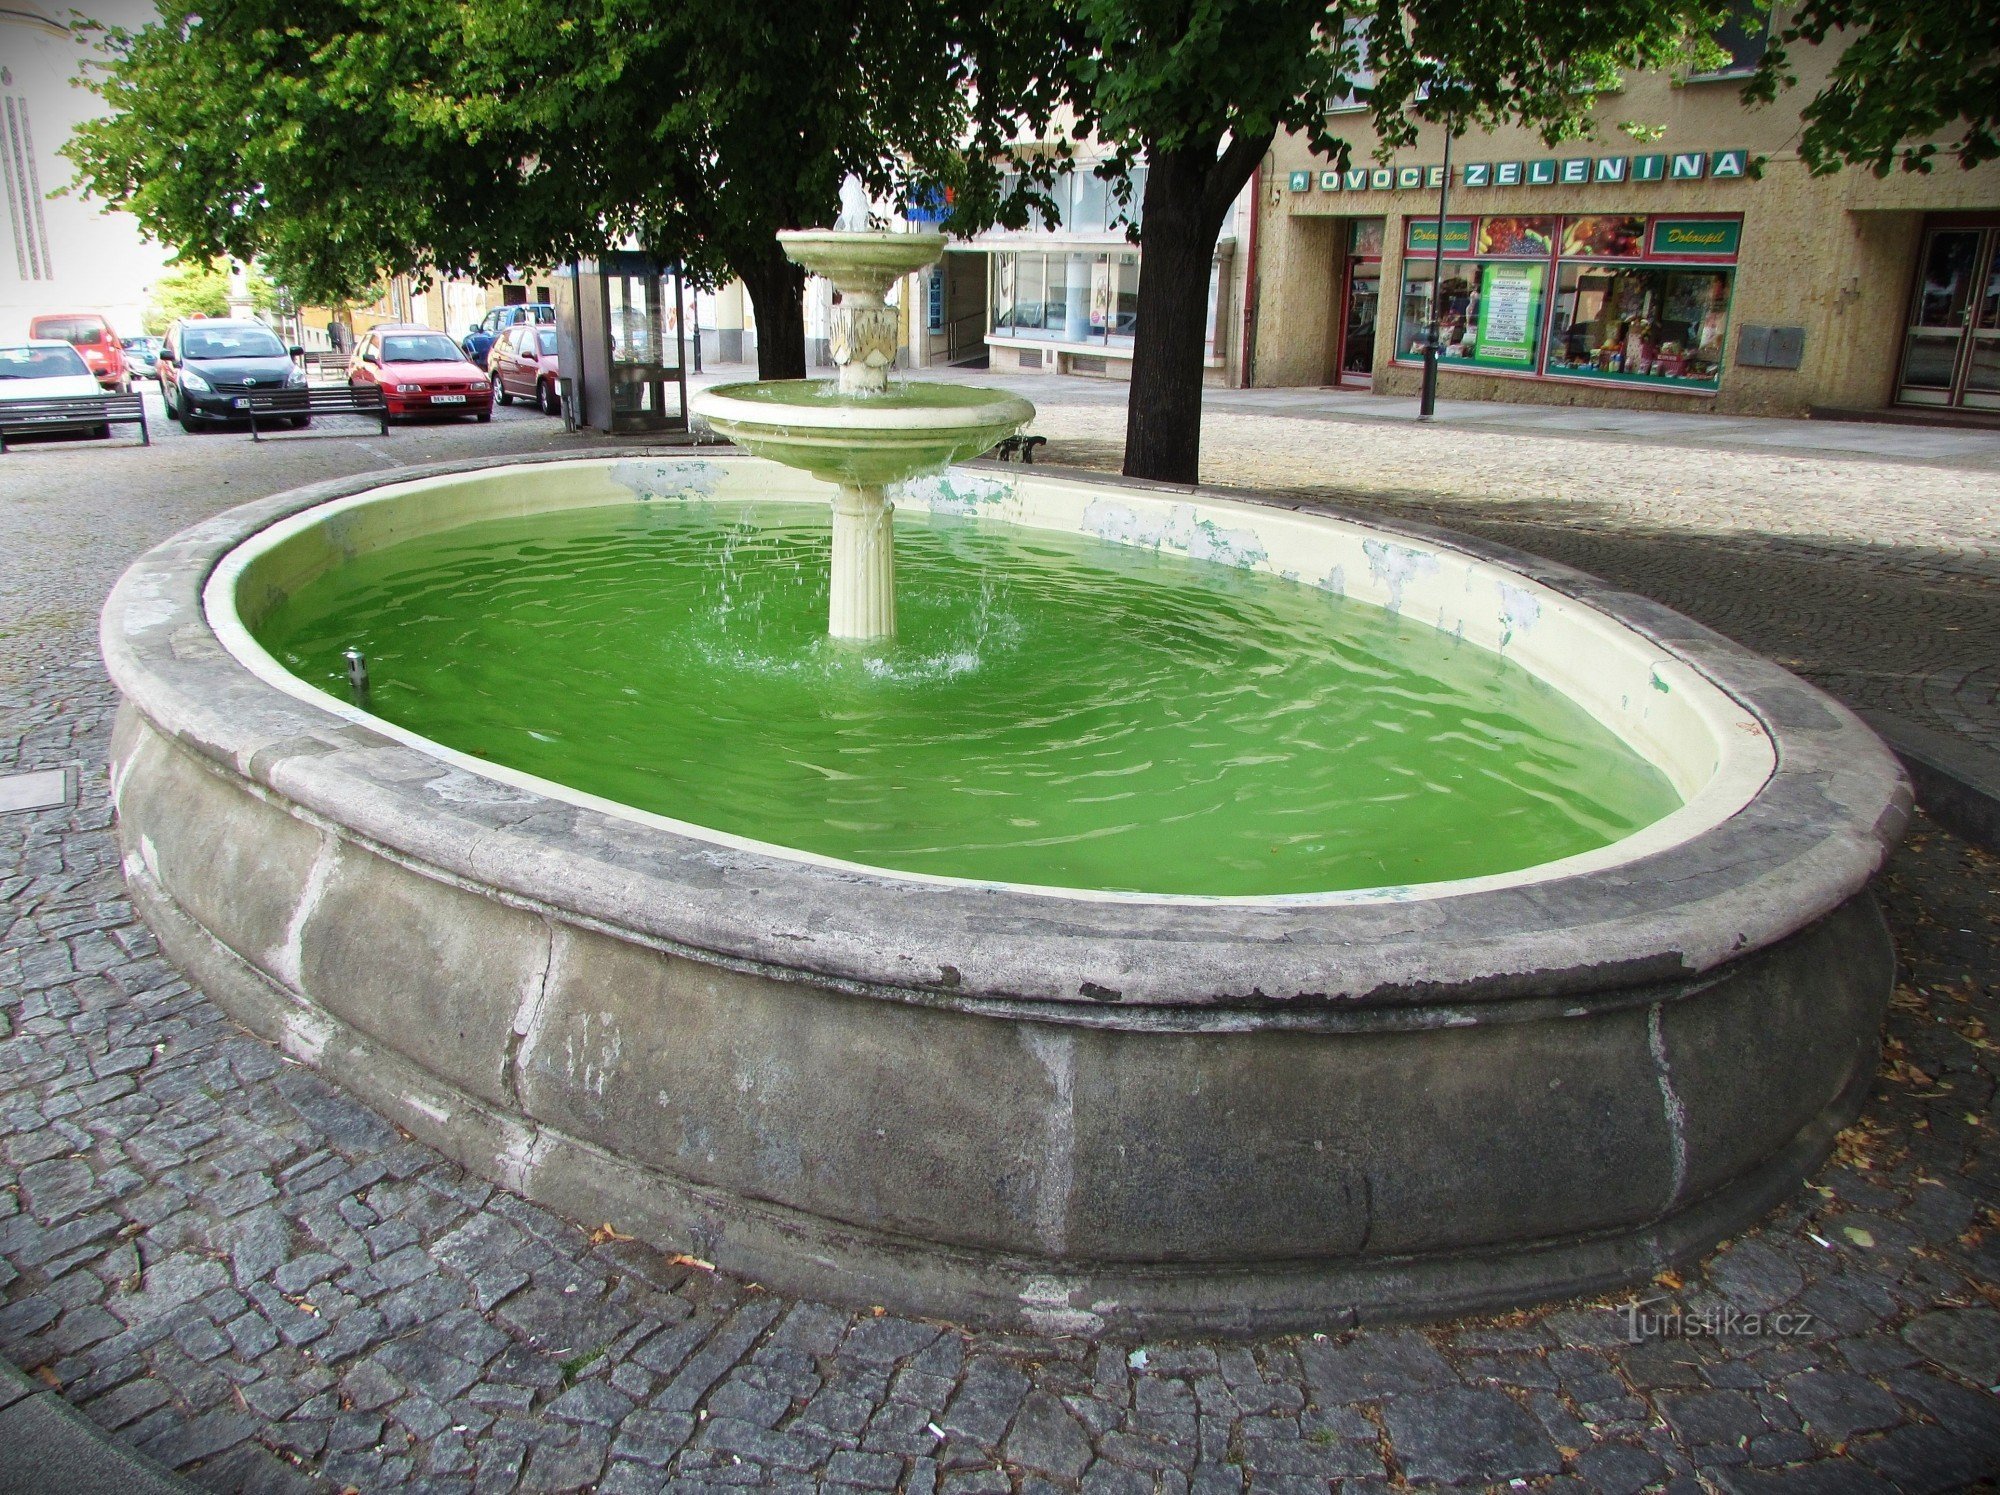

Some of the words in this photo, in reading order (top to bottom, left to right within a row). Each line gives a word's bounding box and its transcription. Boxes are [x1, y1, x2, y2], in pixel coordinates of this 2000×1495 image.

[1321, 167, 1445, 189] OVOCE
[1467, 153, 1740, 184] ZELENINA
[1667, 229, 1726, 245] Dokoupil
